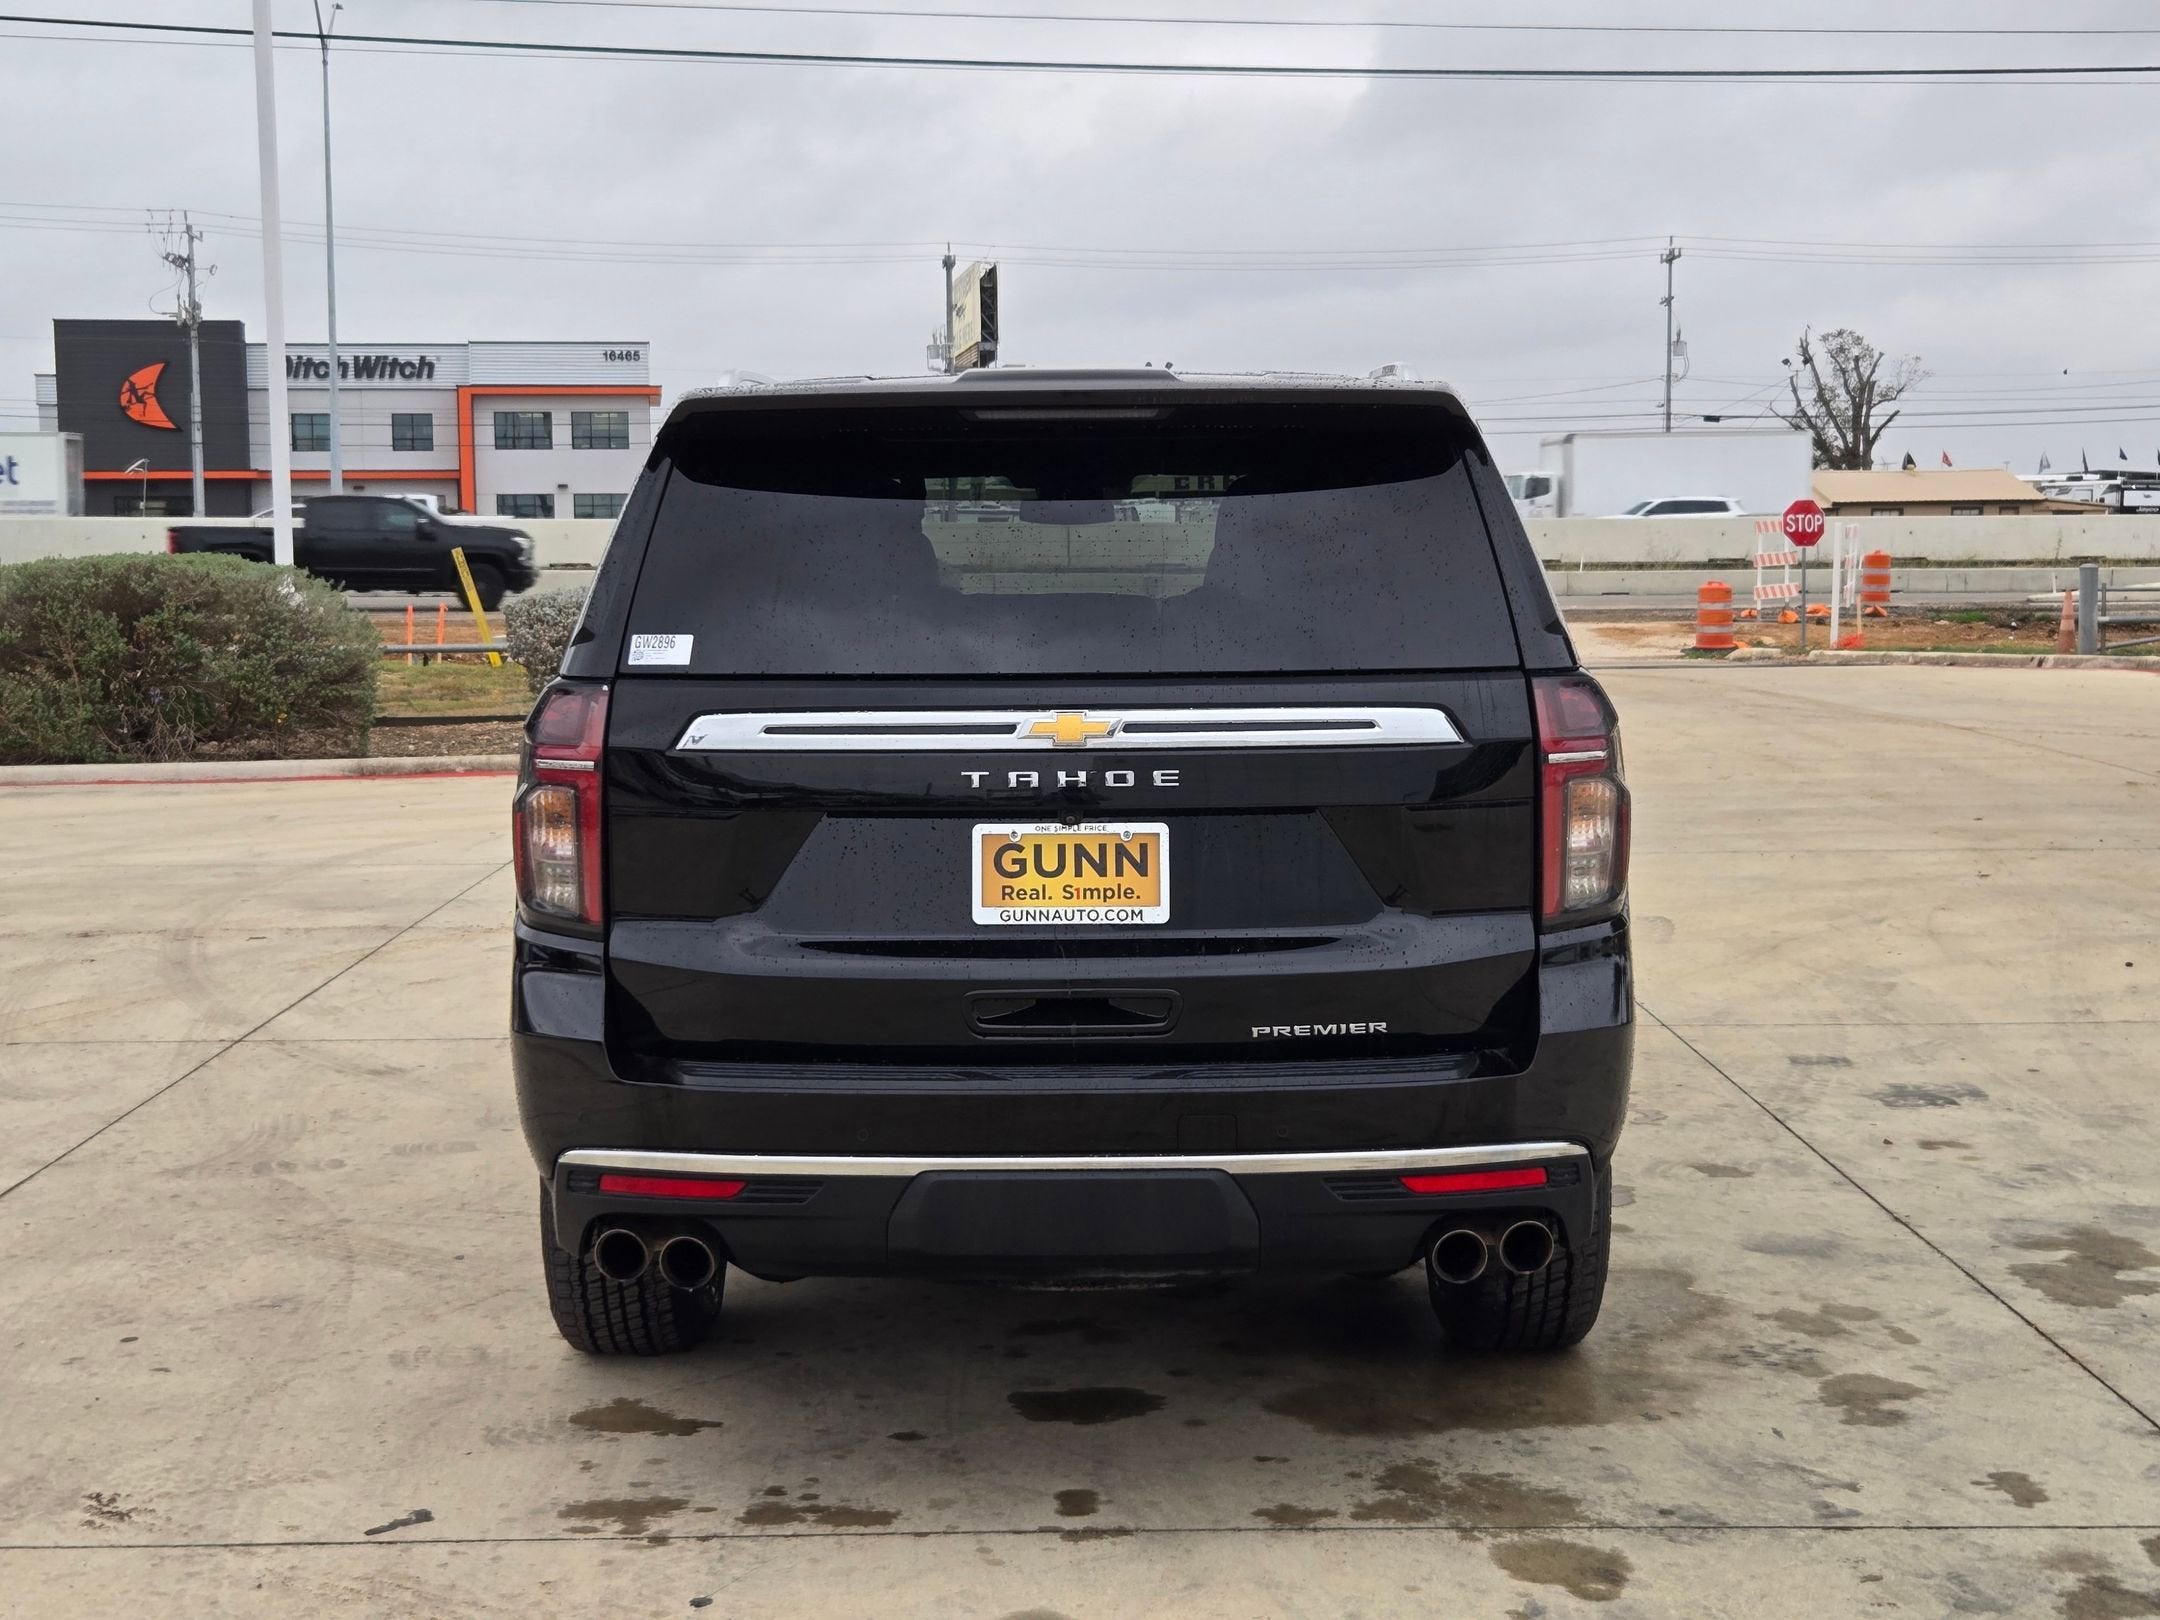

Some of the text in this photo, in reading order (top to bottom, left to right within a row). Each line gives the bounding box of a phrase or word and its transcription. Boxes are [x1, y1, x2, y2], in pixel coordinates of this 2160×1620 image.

[602, 350, 641, 362] 16465
[353, 355, 435, 379] Witch
[1786, 514, 1823, 532] STOP
[634, 635, 676, 649] GW2896
[961, 770, 1180, 788] TAHOE
[993, 842, 1149, 879] GUNN
[1001, 884, 1053, 900] Real.
[1000, 909, 1145, 922] GUNNAUTO.COM
[1251, 1022, 1388, 1038] PREMIER
